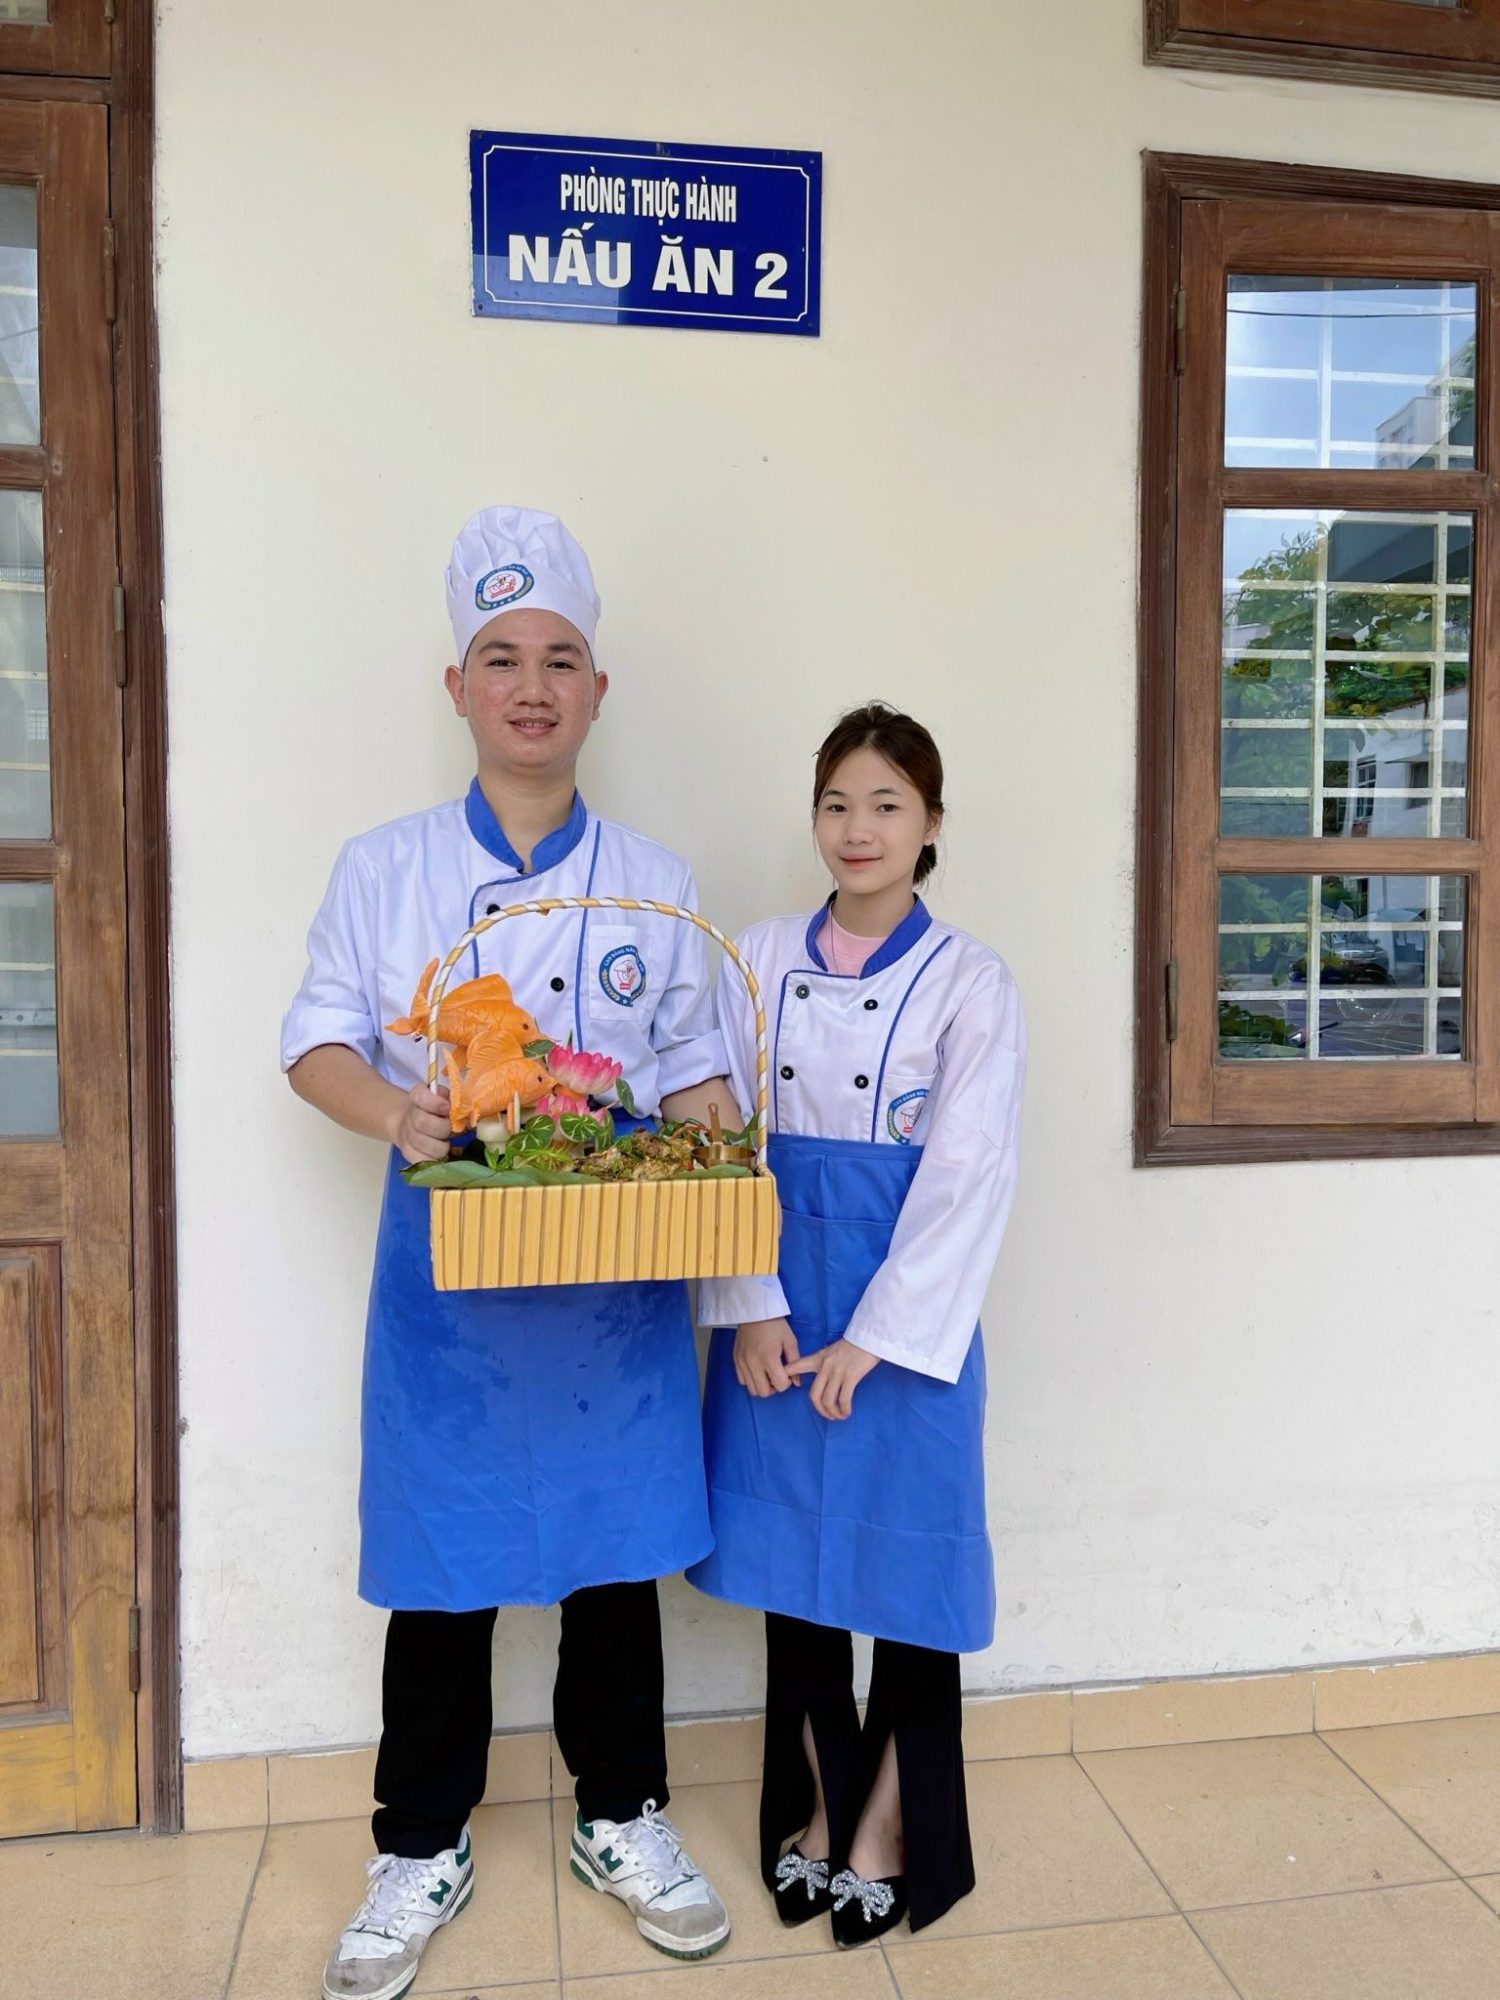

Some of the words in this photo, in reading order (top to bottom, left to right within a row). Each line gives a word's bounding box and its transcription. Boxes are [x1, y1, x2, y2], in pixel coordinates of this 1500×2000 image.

[561, 167, 626, 216] PHÒNG
[631, 176, 680, 226] THỰC
[685, 175, 738, 224] HÀNH
[508, 222, 633, 289] NẤU
[651, 235, 735, 297] ĂN
[754, 252, 789, 300] 2
